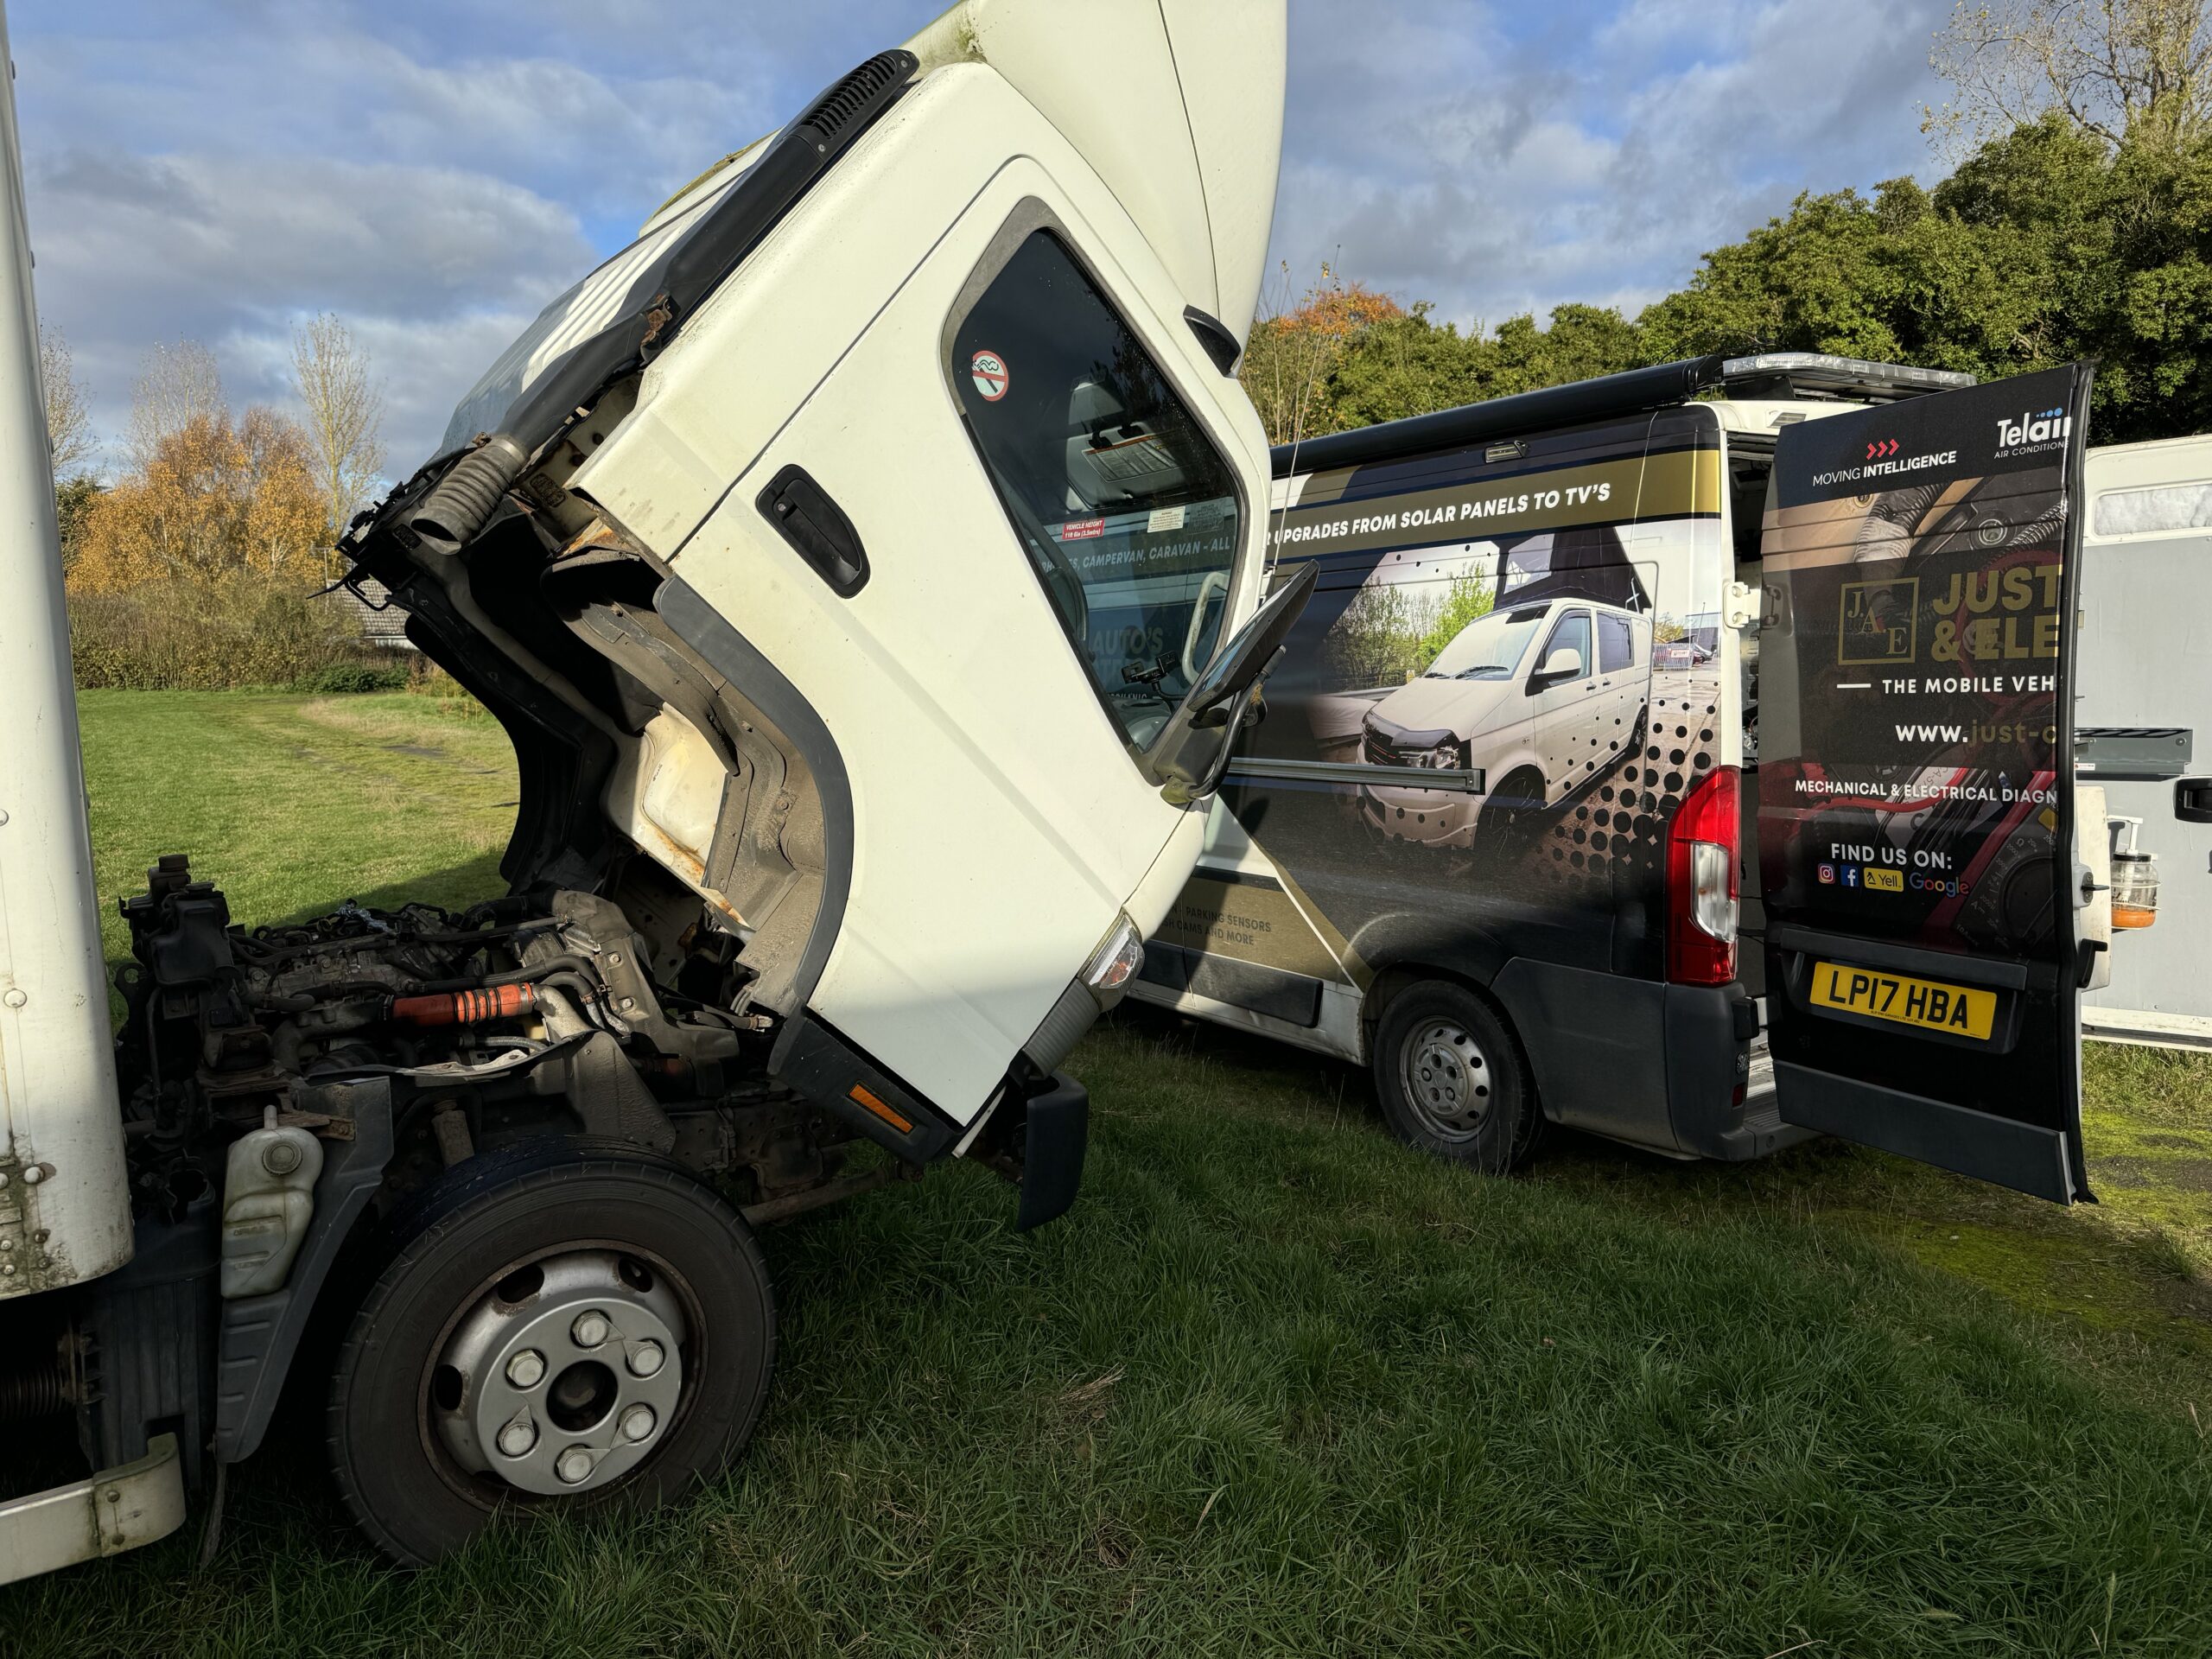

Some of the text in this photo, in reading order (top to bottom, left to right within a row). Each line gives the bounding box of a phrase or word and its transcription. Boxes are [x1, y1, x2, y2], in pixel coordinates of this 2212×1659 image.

[1813, 451, 1956, 486] MOVING INTELLIGENCE
[1994, 450, 2008, 460] AIR
[1066, 520, 1103, 531] VEHICLE HEIGHT
[1274, 520, 1348, 544] UPGRADES
[1352, 512, 1396, 534] FROM
[1401, 505, 1455, 529] SOLAR
[1460, 494, 1529, 520] PANELS
[1534, 491, 1560, 510] TO
[1566, 482, 1611, 505] TV'S
[1083, 550, 1146, 569] CAMPERVAN,
[1149, 541, 1201, 560] CARAVAN
[1210, 539, 1230, 553] ALL
[1932, 565, 2062, 615] JUST
[1093, 627, 1163, 655] AUTO'S
[1930, 615, 2060, 662] & ELE
[1883, 676, 2054, 693] THE MOBILE VEH
[1796, 779, 2056, 804] MECHANICAL & ELECTRICAL DIAGN
[1832, 843, 1952, 869] FIND US ON:
[1878, 874, 1897, 888] Yell
[1910, 873, 1970, 898] Google
[1161, 918, 1254, 945] SH CAMS AND MORE
[1186, 907, 1224, 923] PARKING
[1227, 914, 1272, 932] SENSORS
[1829, 970, 1968, 1028] LP17 HBA
